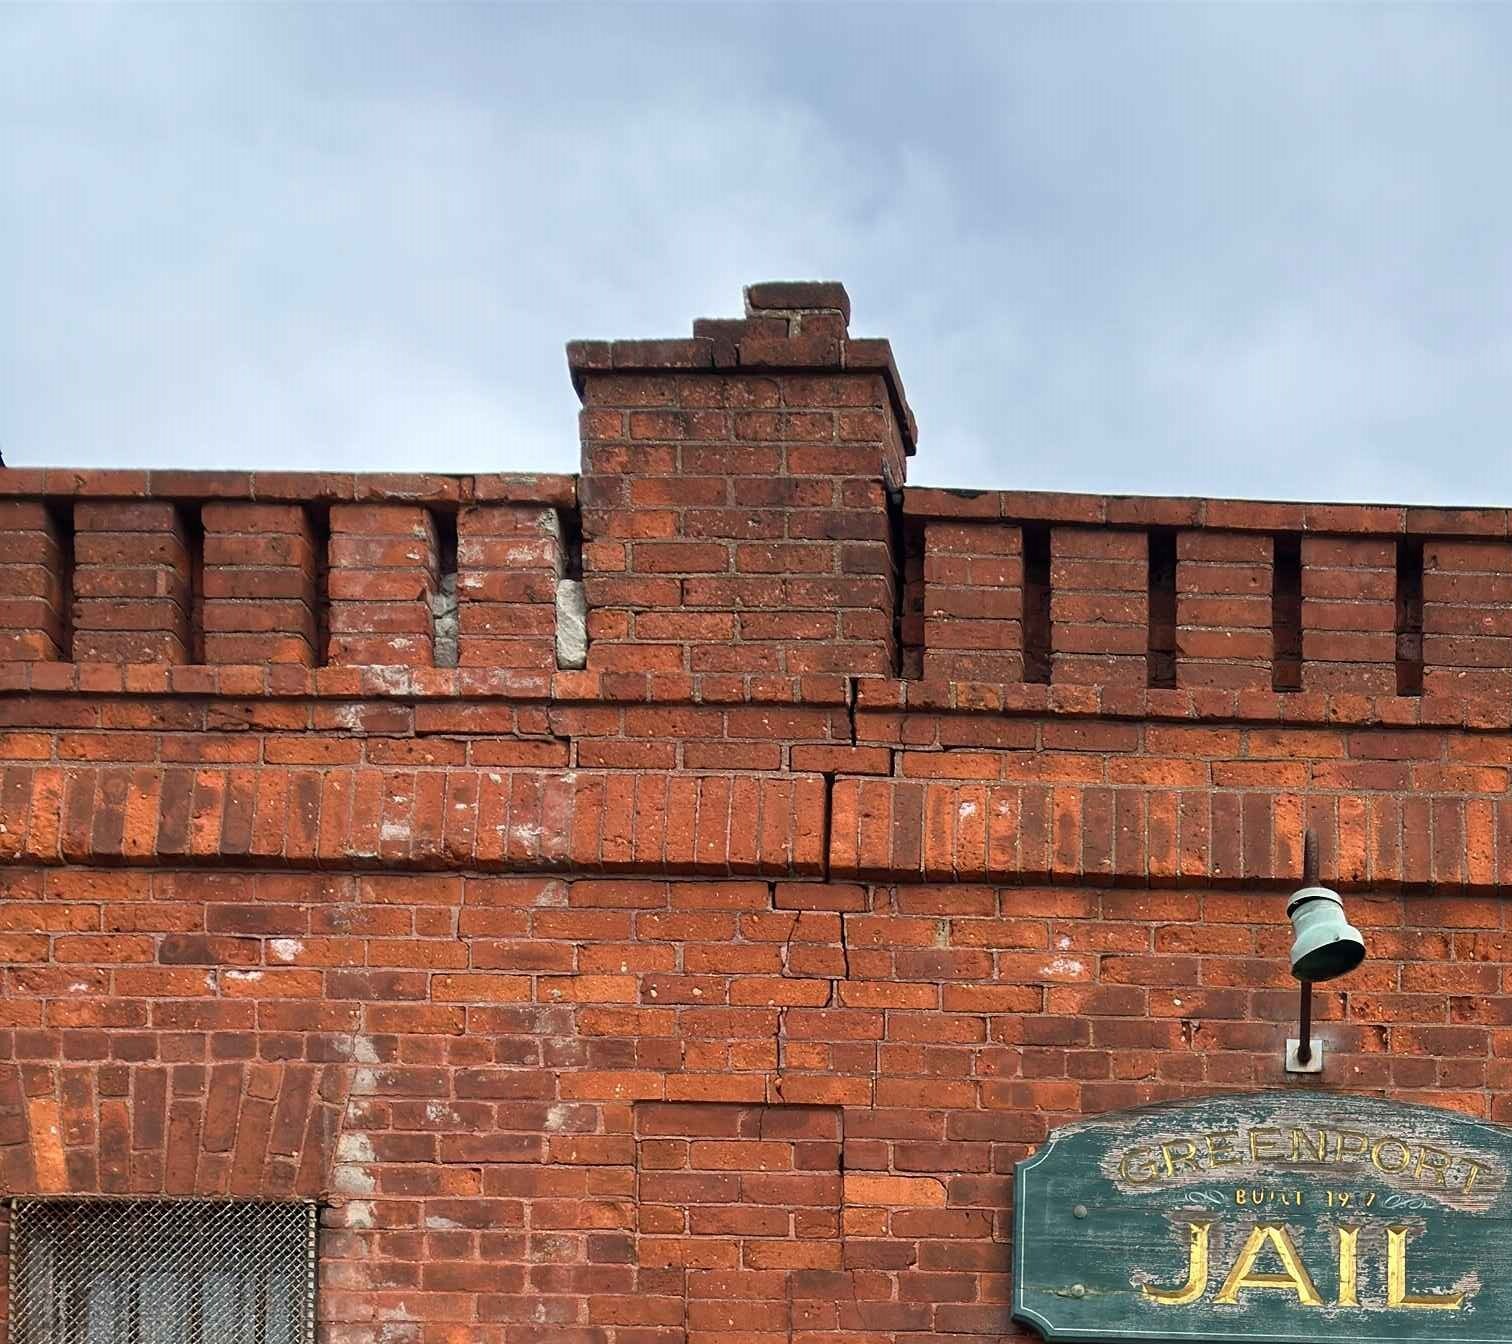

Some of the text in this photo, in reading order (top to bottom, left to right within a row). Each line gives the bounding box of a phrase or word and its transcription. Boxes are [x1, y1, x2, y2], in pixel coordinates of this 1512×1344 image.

[1118, 1127, 1491, 1195] GREENPORT
[1326, 1190, 1376, 1207] 197
[1141, 1222, 1466, 1310] JAIL
